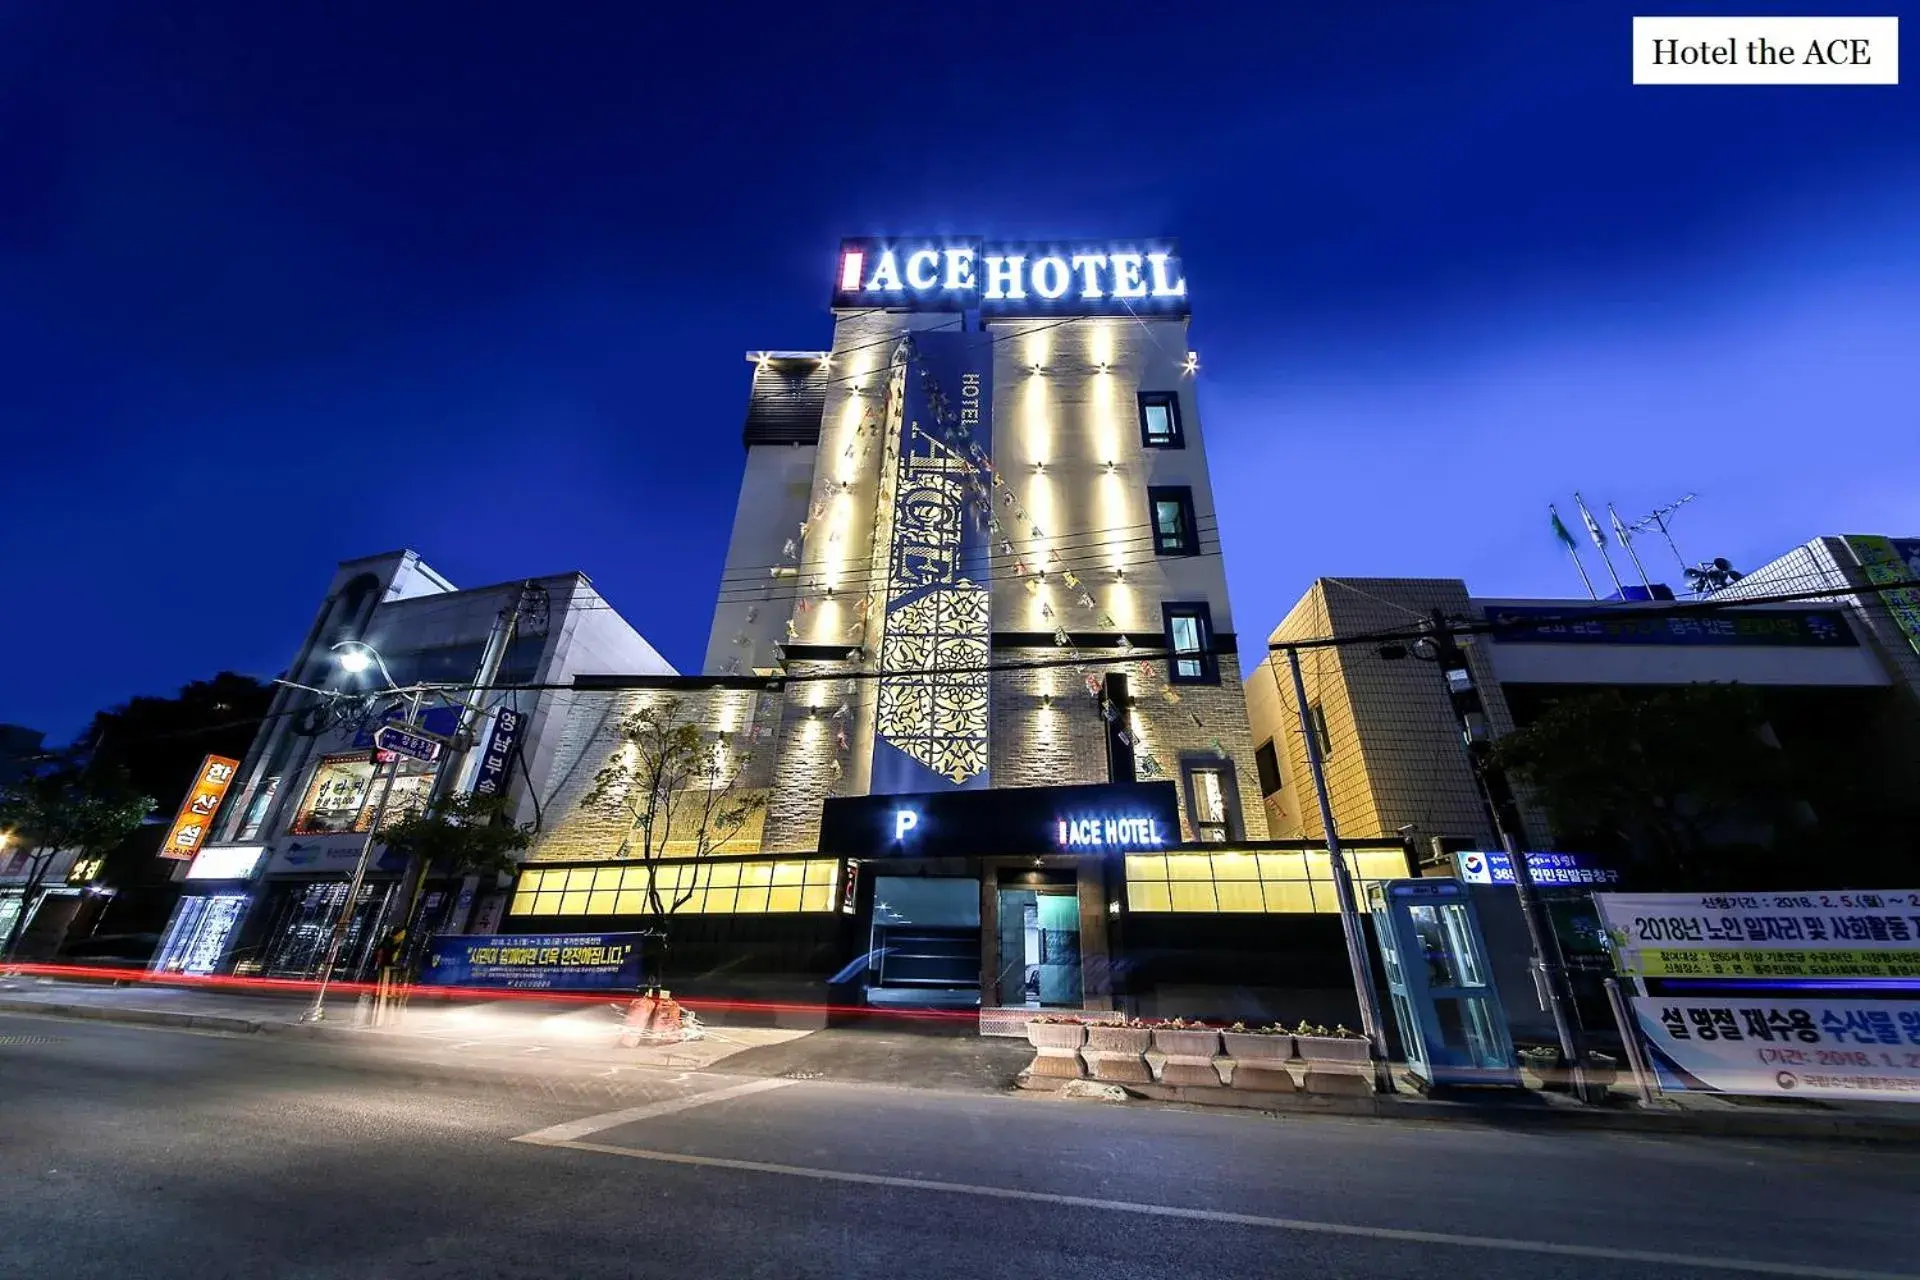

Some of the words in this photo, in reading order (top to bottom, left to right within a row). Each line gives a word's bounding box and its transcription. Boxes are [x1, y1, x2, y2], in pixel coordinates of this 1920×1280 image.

[866, 249, 976, 291] ACE
[984, 253, 1186, 299] HOTEL
[962, 373, 980, 425] HOTEL
[176, 763, 232, 846] 한산섬
[896, 811, 917, 839] P
[1069, 819, 1101, 845] ACE
[1105, 818, 1161, 845] HOTEL
[1530, 868, 1619, 883] 인민원발급창구
[1701, 896, 1758, 910] 신청기간
[1776, 897, 1817, 909] 2018.
[1820, 896, 1837, 908] 2.
[1634, 917, 1703, 942] 2018년
[1706, 917, 1743, 942] 노인
[1743, 917, 1802, 942] 일자리
[1807, 917, 1829, 941] 및
[1830, 915, 1911, 941] 사회활동
[1661, 1007, 1691, 1040] 설
[1689, 1008, 1743, 1042] 명절
[1740, 1007, 1821, 1043] 제수용
[1821, 1010, 1902, 1044] 수산물
